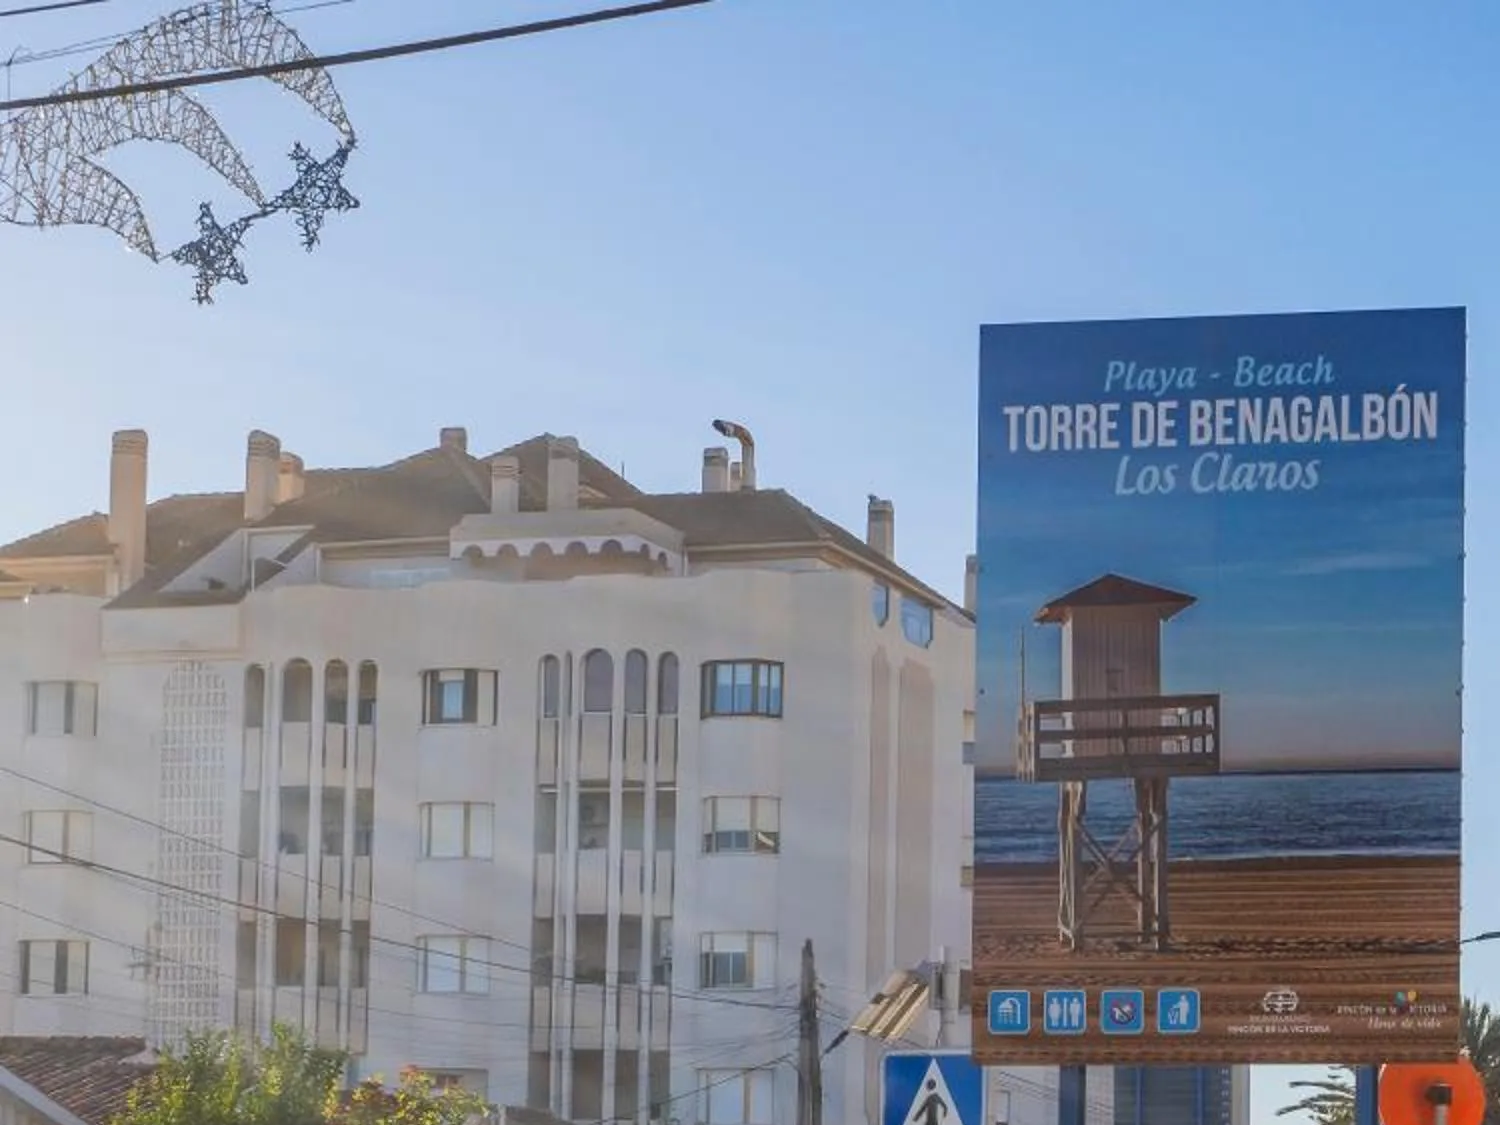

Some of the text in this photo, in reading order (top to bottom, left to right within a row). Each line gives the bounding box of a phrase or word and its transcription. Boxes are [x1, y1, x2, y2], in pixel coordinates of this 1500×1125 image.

[1104, 360, 1197, 397] Playa
[1233, 355, 1335, 388] Beach
[1003, 383, 1437, 453] TORRE DE BENAGALBÓN
[1115, 452, 1321, 496] Los Claros
